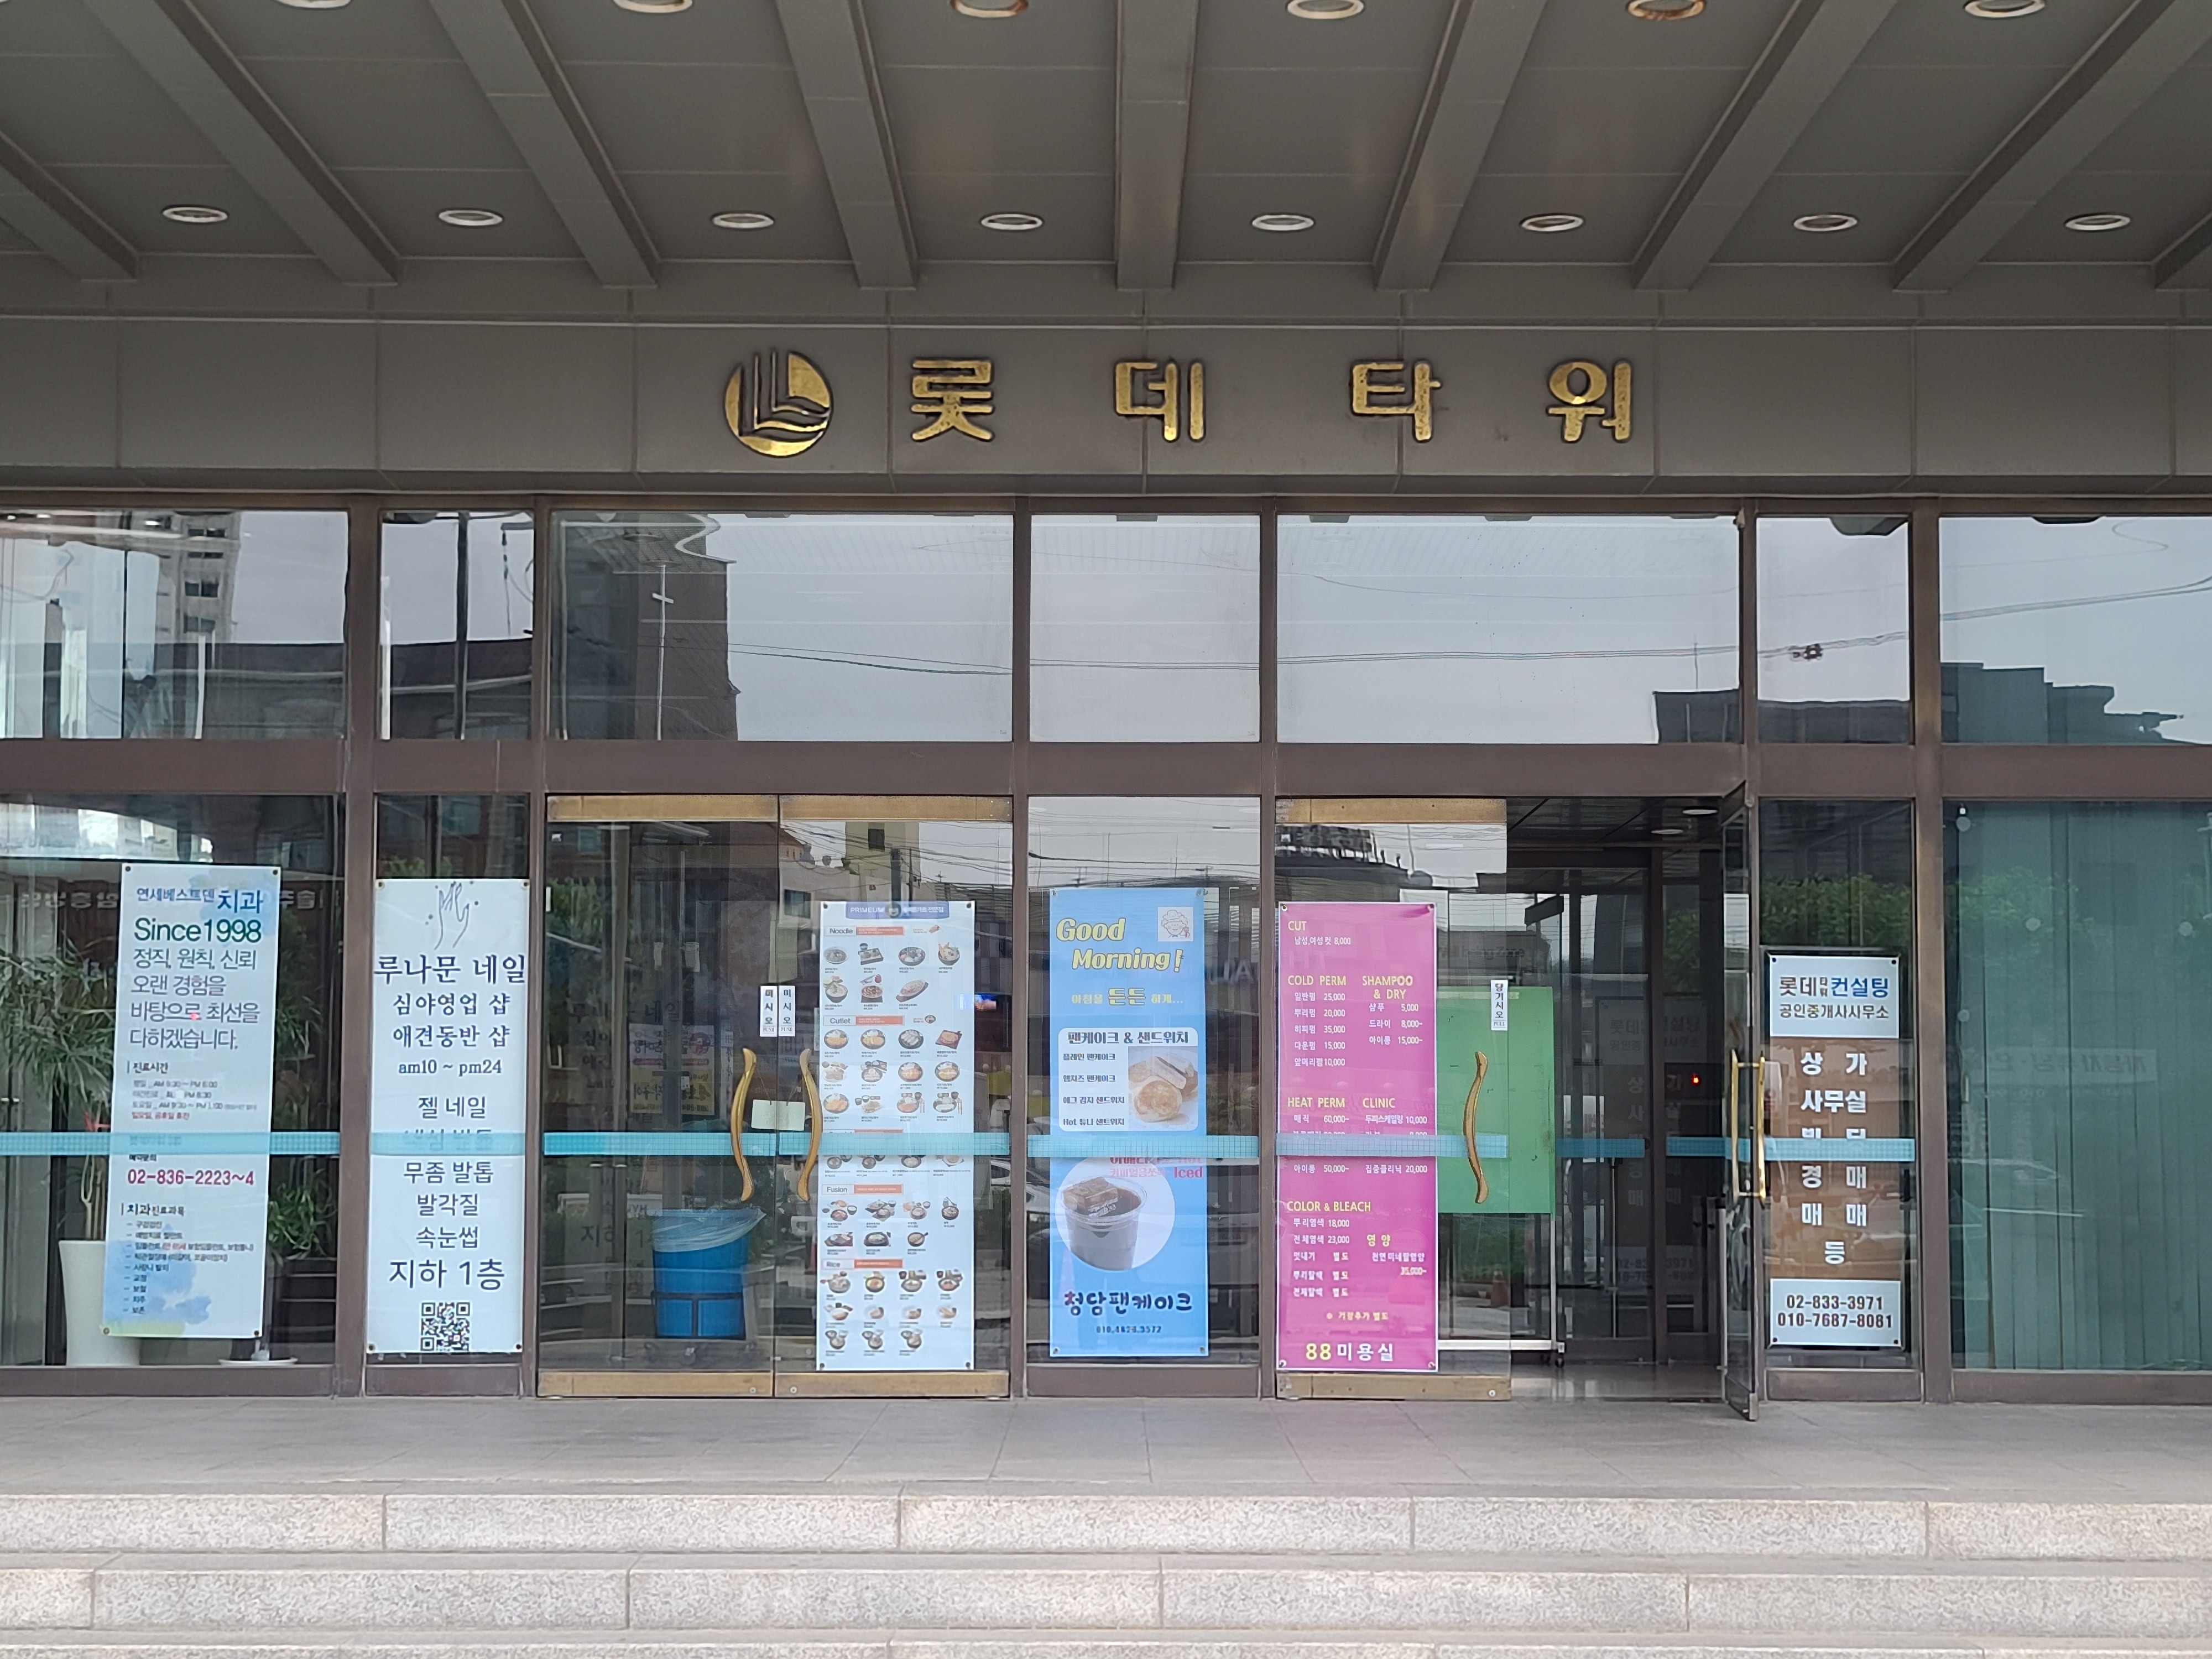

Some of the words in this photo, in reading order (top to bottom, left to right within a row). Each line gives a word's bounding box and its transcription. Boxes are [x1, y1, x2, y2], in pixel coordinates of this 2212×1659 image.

[217, 889, 264, 914] 치과
[134, 917, 262, 943] Since1998
[1056, 917, 1126, 942] Good
[1288, 921, 1307, 931] CUT
[133, 948, 172, 969] 정직,
[178, 948, 216, 970] 원칙,
[221, 950, 257, 970] 신뢰
[374, 954, 461, 984] 루나문
[473, 954, 525, 984] 네일
[131, 974, 168, 996] 오랜
[173, 975, 226, 997] 경험을
[1288, 975, 1314, 985] COLD
[1319, 975, 1347, 986] PERM
[1362, 975, 1413, 986] SHAMPOO
[1071, 994, 1103, 1005] 아침을
[1108, 987, 1146, 1006] 든든
[1294, 993, 1316, 1001] 일반펌
[1374, 990, 1381, 999] &
[1386, 989, 1406, 999] DRY
[131, 1001, 202, 1023] 바탕으로
[206, 1003, 260, 1024] 최선을
[393, 993, 477, 1016] 심야영업
[489, 993, 510, 1015] 샵
[764, 989, 774, 1024] 미시오
[782, 989, 791, 1024] 미시오
[1780, 1004, 1889, 1019] 공인중개사사무소
[1369, 1020, 1391, 1029] 드라이
[130, 1027, 238, 1050] 다하겠습니다.
[393, 1025, 480, 1048] 애견동반
[488, 1025, 510, 1047] 샵
[1068, 1031, 1119, 1044] 팬케이크
[1123, 1032, 1134, 1044] &
[1294, 1041, 1316, 1050] 다운펌
[1369, 1036, 1391, 1045] 아이롱
[398, 1059, 437, 1074] am10
[458, 1059, 502, 1077] pm24
[419, 1096, 437, 1119] 젤
[446, 1097, 485, 1119] 네일
[1287, 1097, 1313, 1107] HEAT
[1318, 1098, 1345, 1108] PERM
[1363, 1098, 1396, 1108] CLINIC
[1801, 1089, 1866, 1113] 사무실
[128, 1168, 254, 1186] 02-836-2223~4
[404, 1162, 445, 1184] 무좀
[452, 1161, 493, 1183] 발톱
[1173, 1166, 1203, 1178] Iced
[1293, 1165, 1316, 1173] 아이롱
[1365, 1165, 1402, 1173] 집중클리닉
[1405, 1165, 1428, 1173] 20,000
[418, 1193, 478, 1216] 발각질
[1287, 1201, 1321, 1212] COLOR
[1324, 1203, 1330, 1212] &
[1333, 1202, 1371, 1212] BLEACH
[1328, 1219, 1350, 1228] 18,000
[416, 1226, 478, 1249] 속눈썹
[1328, 1236, 1350, 1244] 23,000
[1824, 1241, 1845, 1264] 등
[389, 1259, 447, 1289] 지하
[459, 1258, 504, 1290] 1층
[1065, 1291, 1192, 1316] 청담팬케이크
[1786, 1295, 1883, 1310] 02-833-3971
[1777, 1312, 1892, 1328] 010-7687-8081
